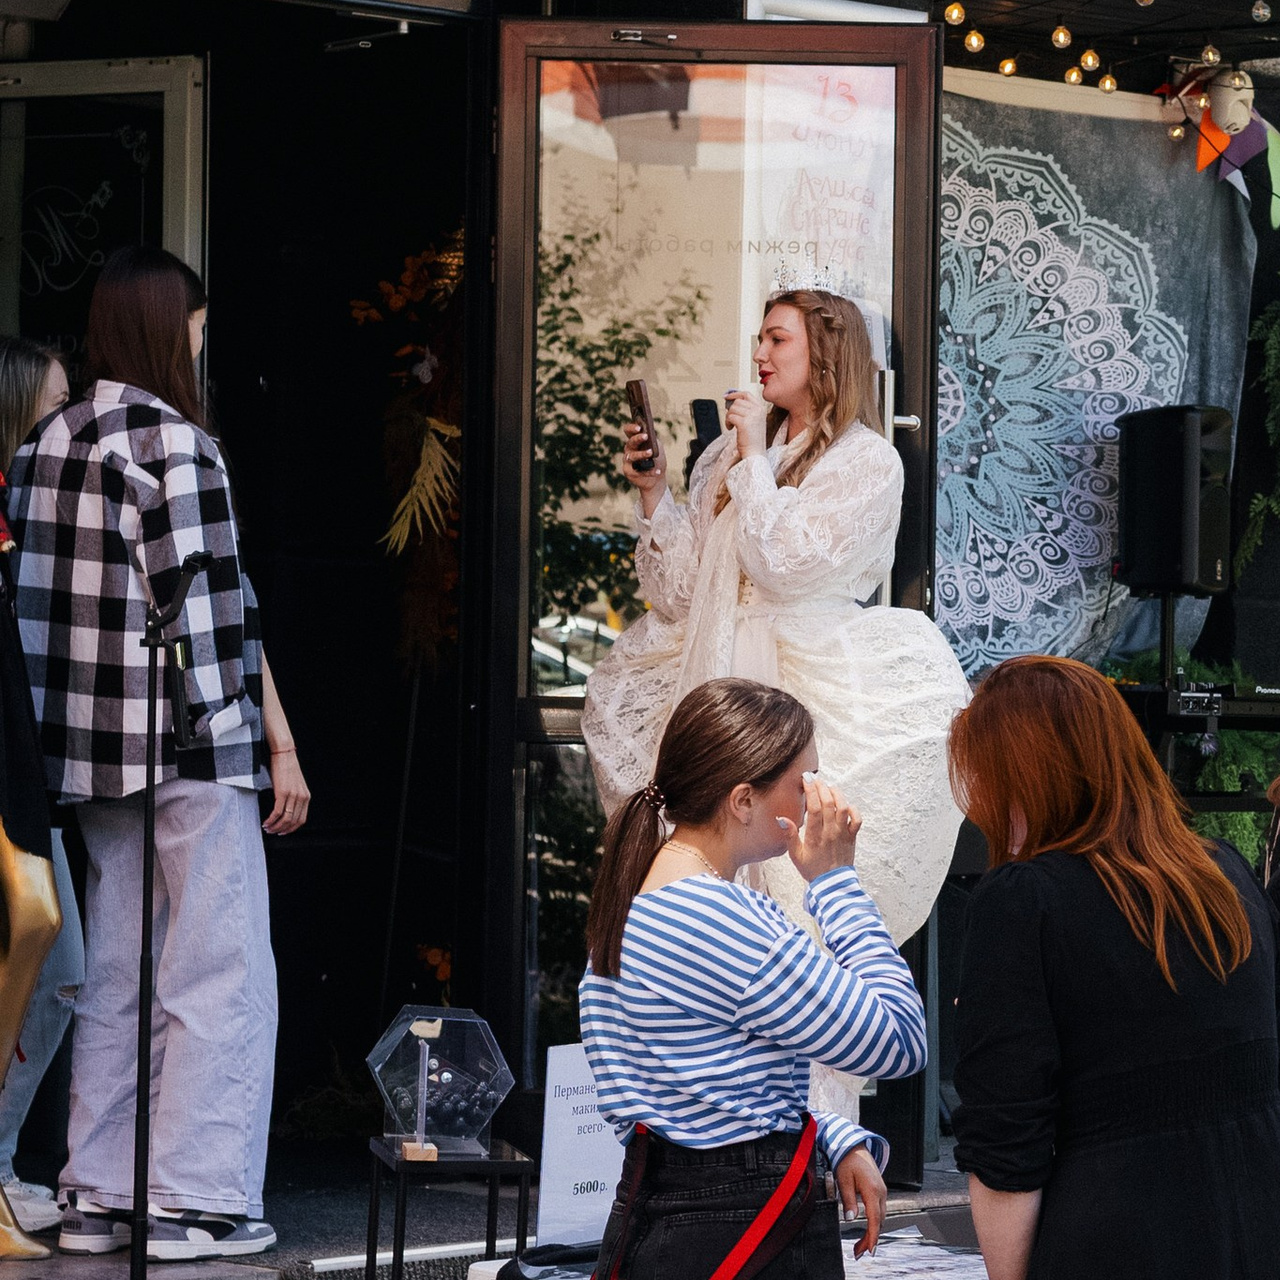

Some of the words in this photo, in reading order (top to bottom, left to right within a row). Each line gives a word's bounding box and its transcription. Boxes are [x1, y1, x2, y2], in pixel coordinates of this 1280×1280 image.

[817, 74, 860, 124] 13
[554, 1083, 598, 1100] Пермане
[572, 1104, 599, 1116] маки
